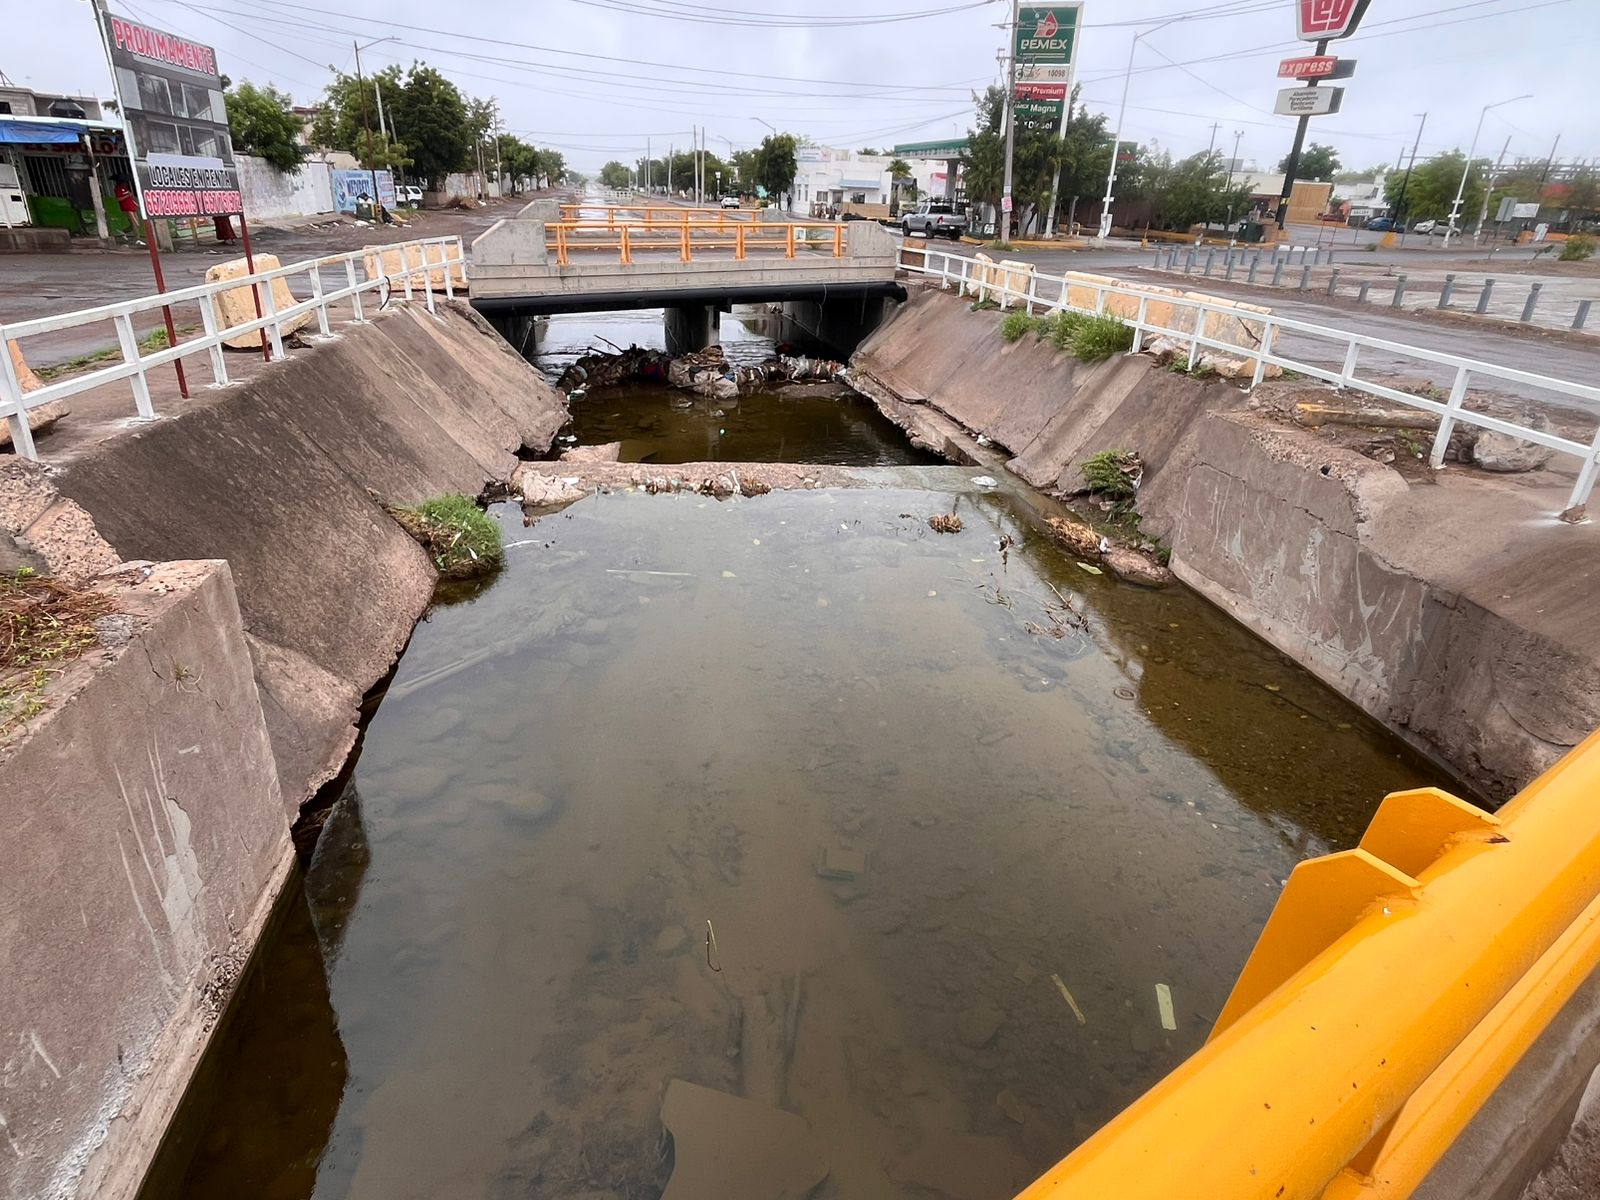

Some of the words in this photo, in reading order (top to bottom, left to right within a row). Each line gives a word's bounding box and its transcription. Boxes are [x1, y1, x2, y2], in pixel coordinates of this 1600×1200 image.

[111, 17, 215, 76] PROXIMAMENTE
[1021, 39, 1068, 50] PEMEX
[1280, 61, 1333, 75] express
[1032, 86, 1064, 95] Premium
[1030, 104, 1056, 114] Magna
[149, 165, 192, 187] LOCALES
[192, 168, 207, 188] EN
[205, 169, 231, 188] RENTA
[195, 190, 203, 214] Y
